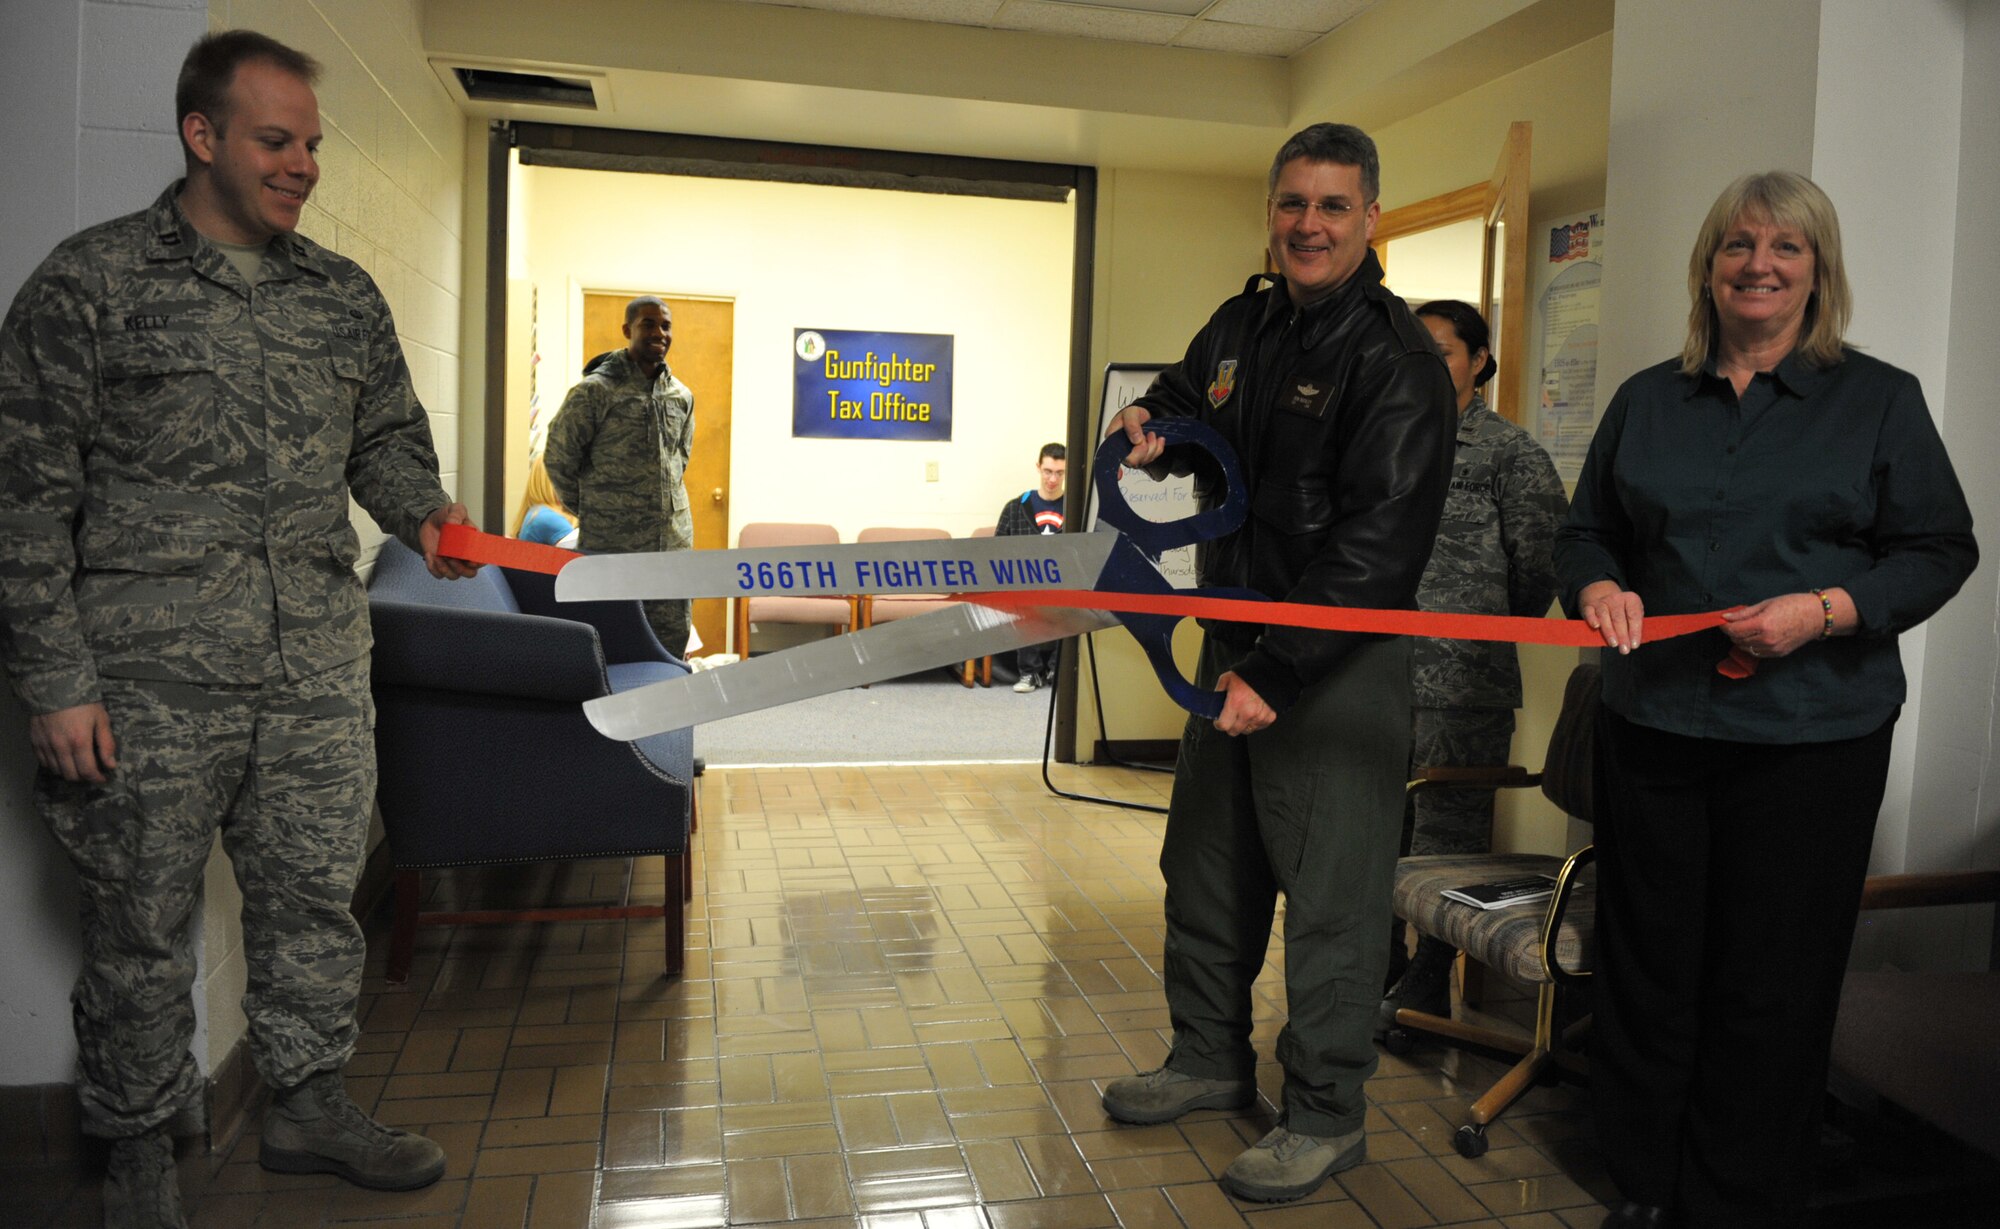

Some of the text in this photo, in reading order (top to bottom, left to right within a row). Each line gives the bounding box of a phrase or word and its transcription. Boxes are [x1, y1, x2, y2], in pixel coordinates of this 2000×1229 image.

[123, 315, 170, 331] KELLY
[825, 350, 936, 387] Gunfighter
[827, 390, 931, 422] Tax Office
[1173, 486, 1188, 502] For
[736, 558, 1062, 590] 366TH FIGHTER WING
